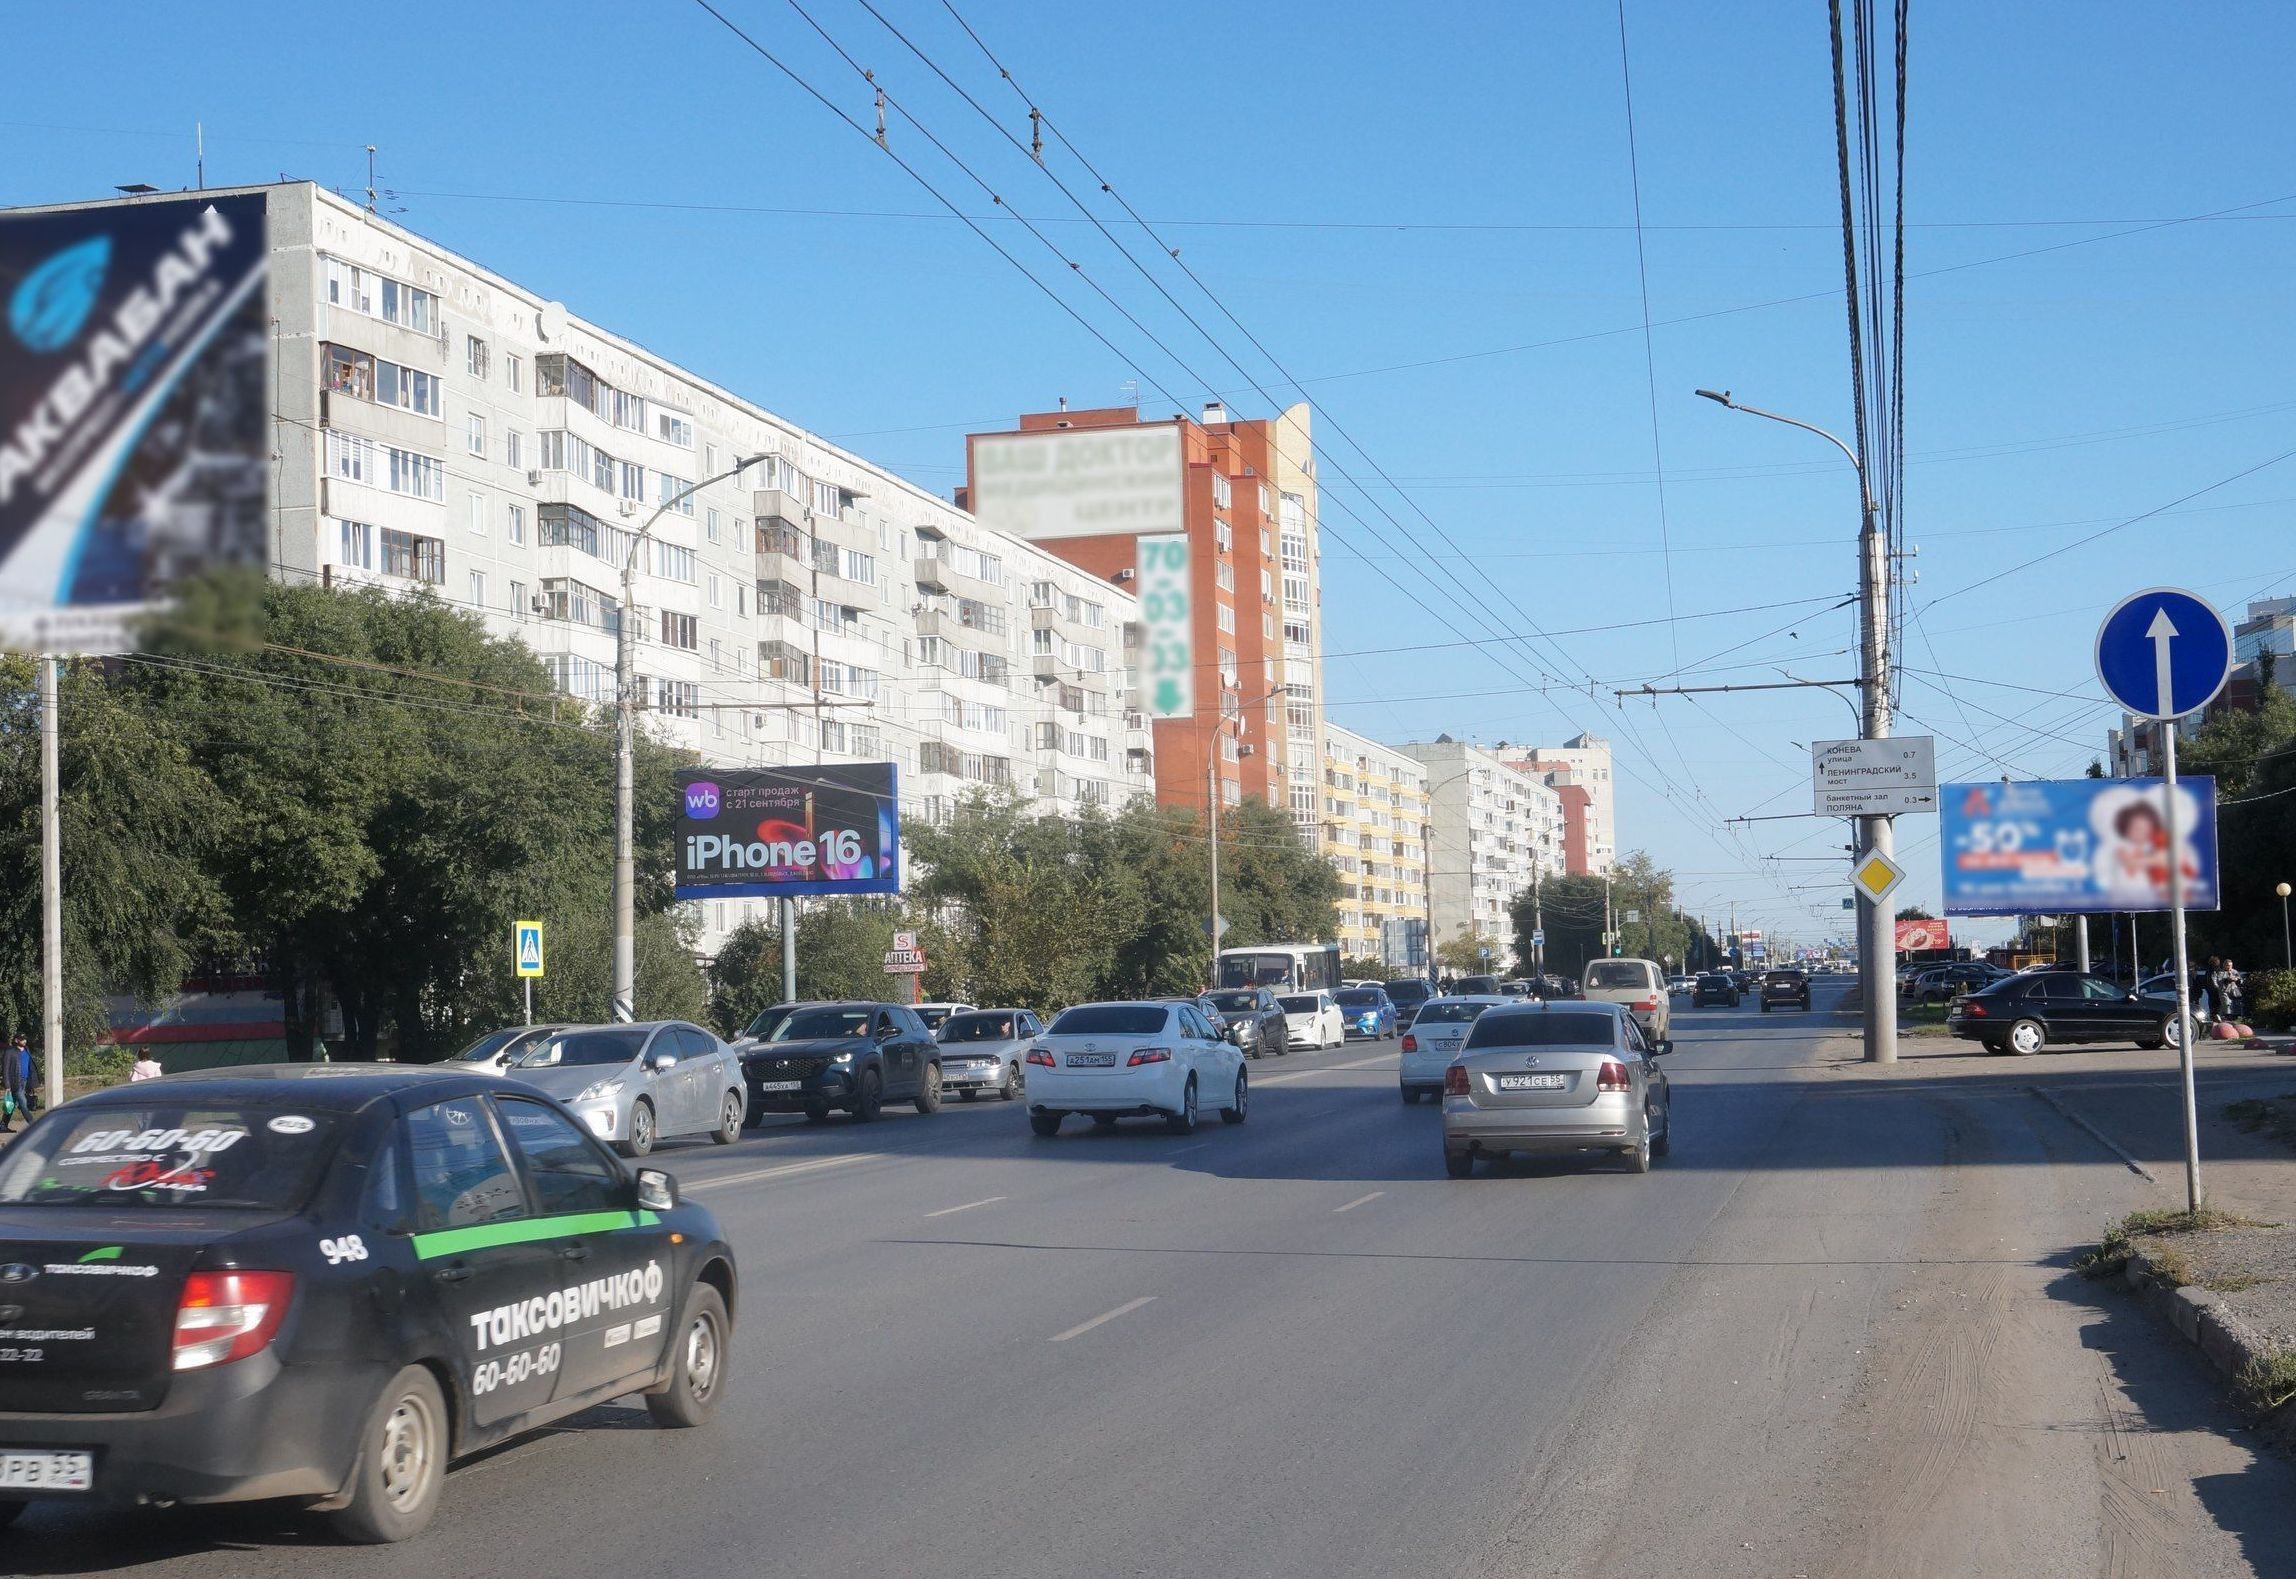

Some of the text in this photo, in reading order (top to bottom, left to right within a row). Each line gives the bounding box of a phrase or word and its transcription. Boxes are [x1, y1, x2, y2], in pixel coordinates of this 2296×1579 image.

[1827, 746, 1862, 754] КОНЕВА
[1827, 756, 1852, 764] улица
[1827, 765, 1902, 777] ЛЕНИНГРАДСКИЙ
[687, 789, 718, 808] wb
[726, 786, 800, 799] старт продаж
[1827, 794, 1872, 802] банкетный
[735, 800, 747, 809] 21
[750, 798, 800, 809] сентября
[1827, 804, 1863, 812] ПОЛЯНА
[687, 829, 862, 870] iPhone 16
[884, 950, 924, 964] АПТЕКА
[70, 1129, 245, 1153] 60-60-60
[319, 1234, 369, 1265] 948
[472, 1343, 562, 1396] 60-60-60
